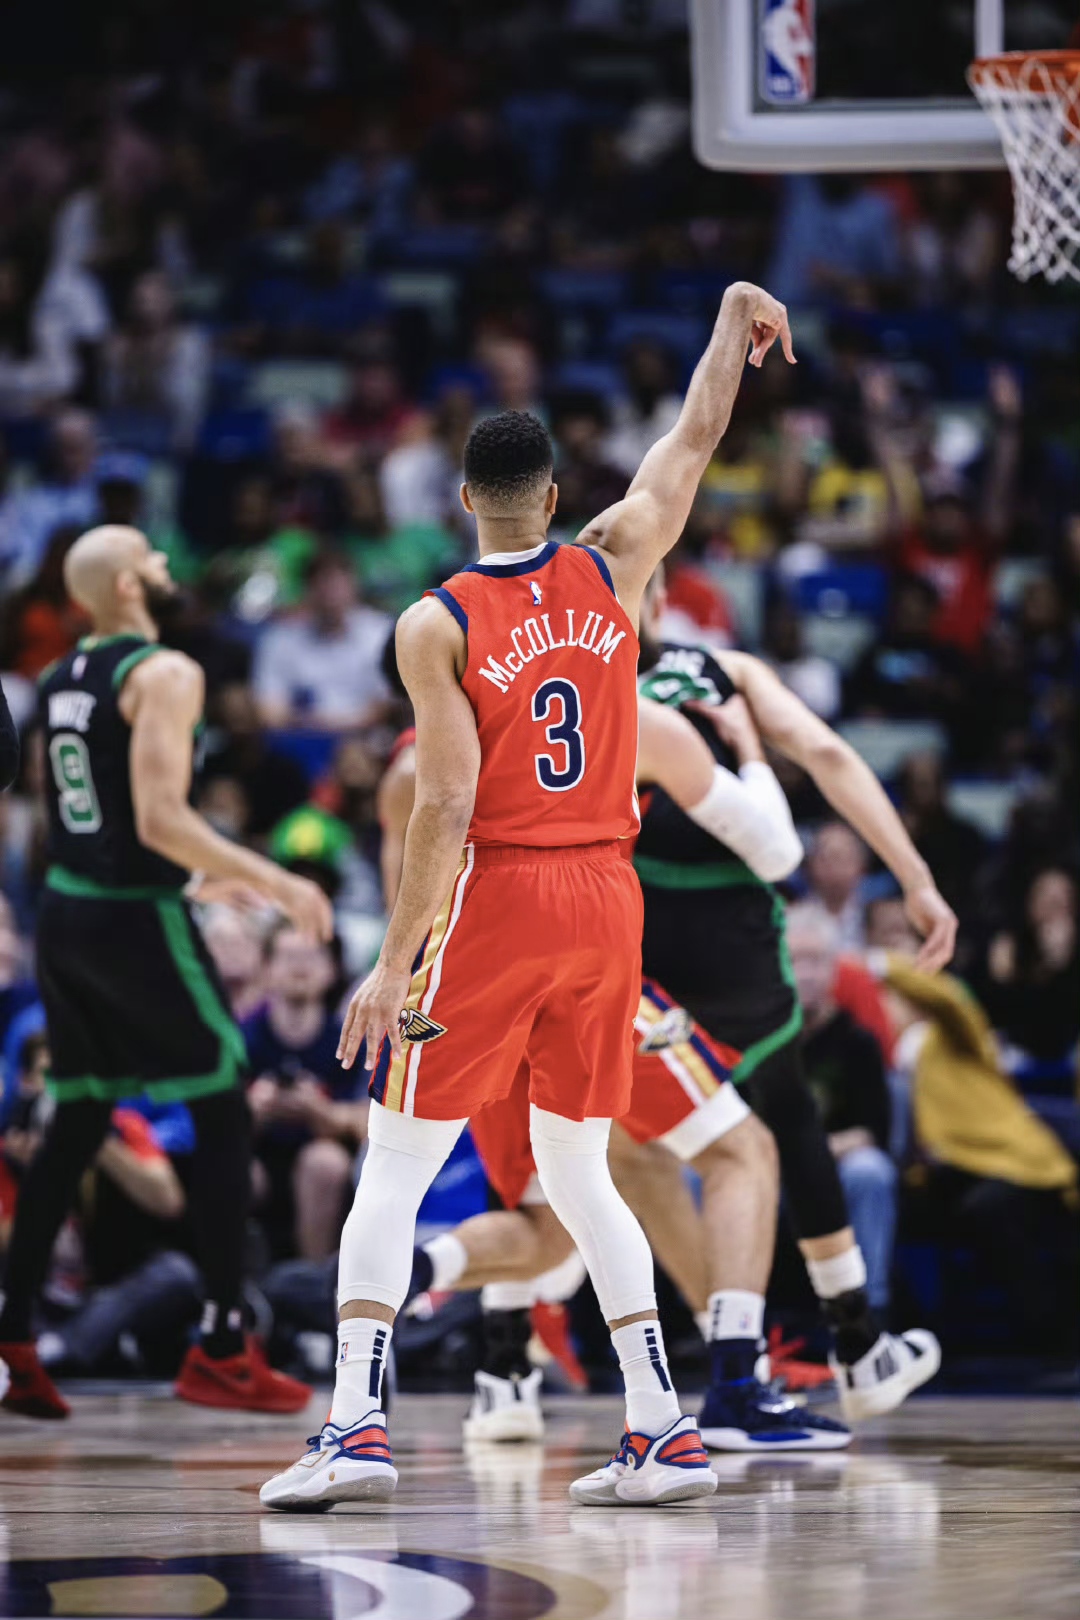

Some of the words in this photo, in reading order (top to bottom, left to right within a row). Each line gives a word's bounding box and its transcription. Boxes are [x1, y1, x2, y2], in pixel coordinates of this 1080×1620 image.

[478, 609, 626, 694] McCOLLUM
[49, 732, 103, 834] 9
[531, 677, 586, 792] 3
